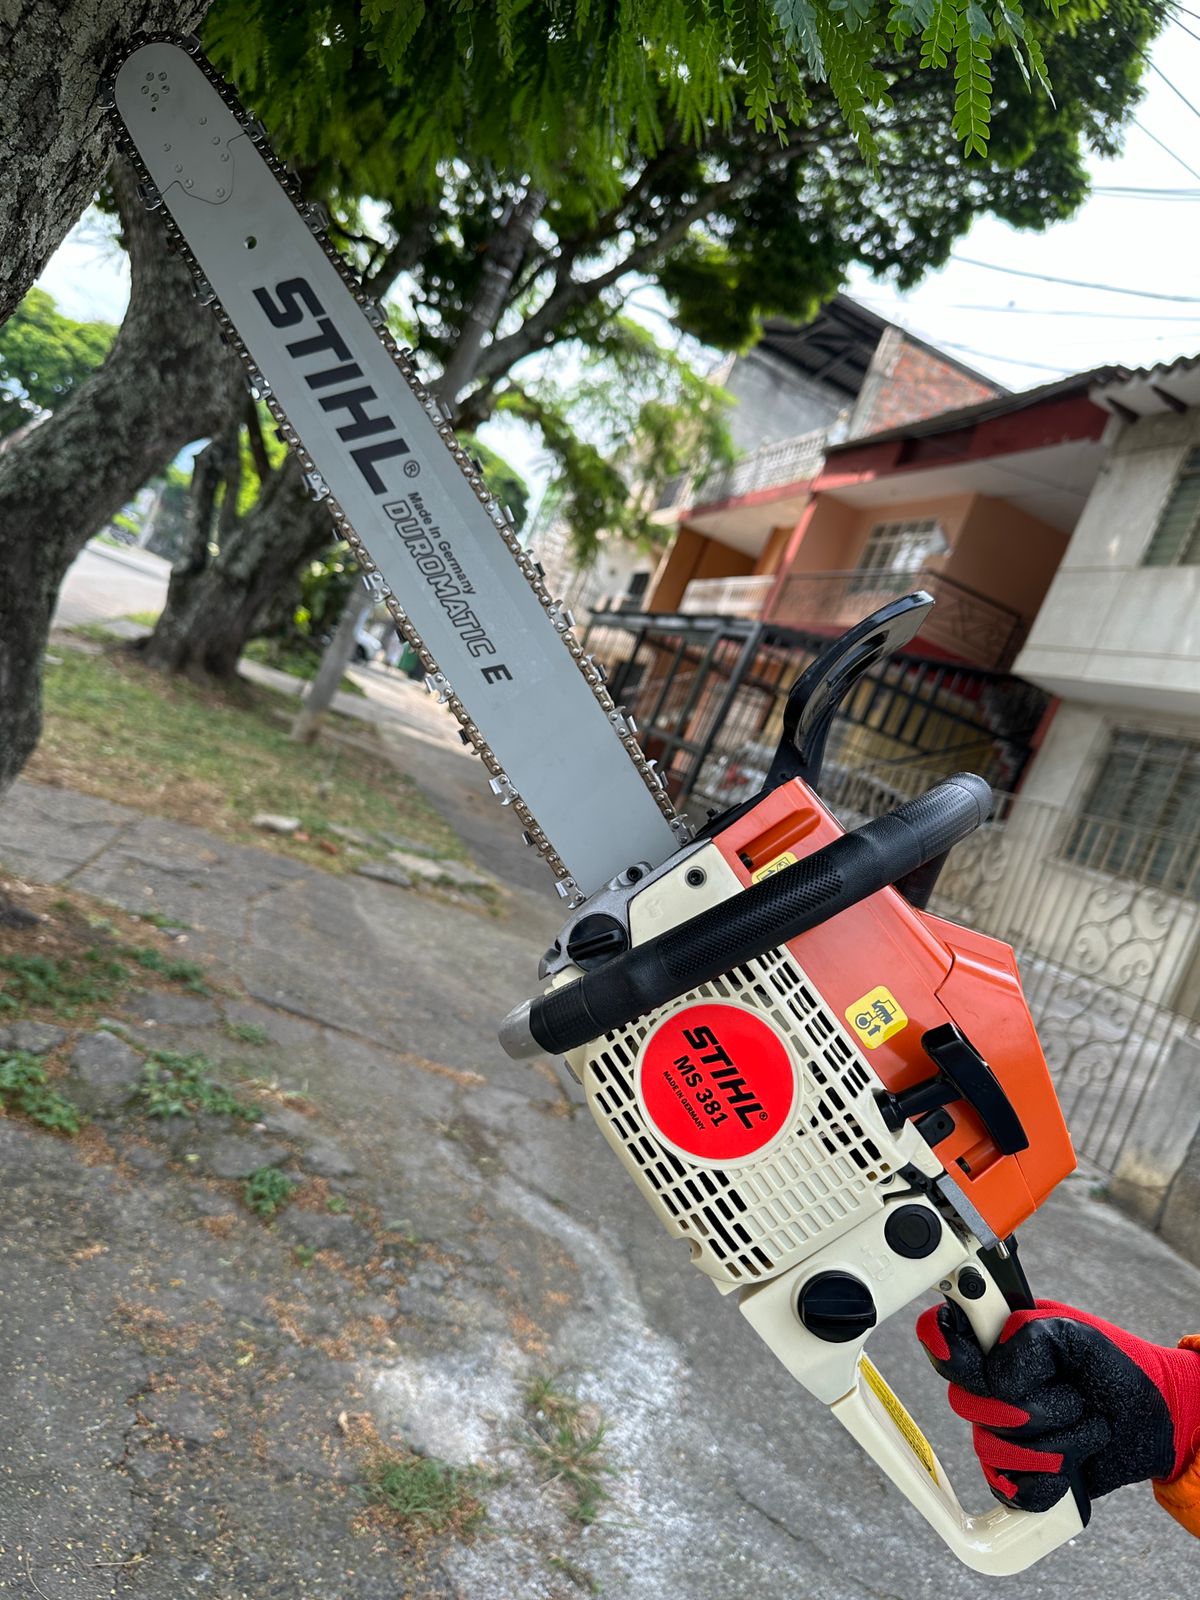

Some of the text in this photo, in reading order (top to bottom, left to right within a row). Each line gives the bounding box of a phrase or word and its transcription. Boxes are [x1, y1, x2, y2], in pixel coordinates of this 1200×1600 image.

[408, 491, 433, 525] Made
[438, 541, 476, 594] Germany
[382, 499, 513, 685] DUROMATIC E
[663, 1071, 706, 1130] MADE IN GERMANY
[673, 1055, 729, 1128] MS 381
